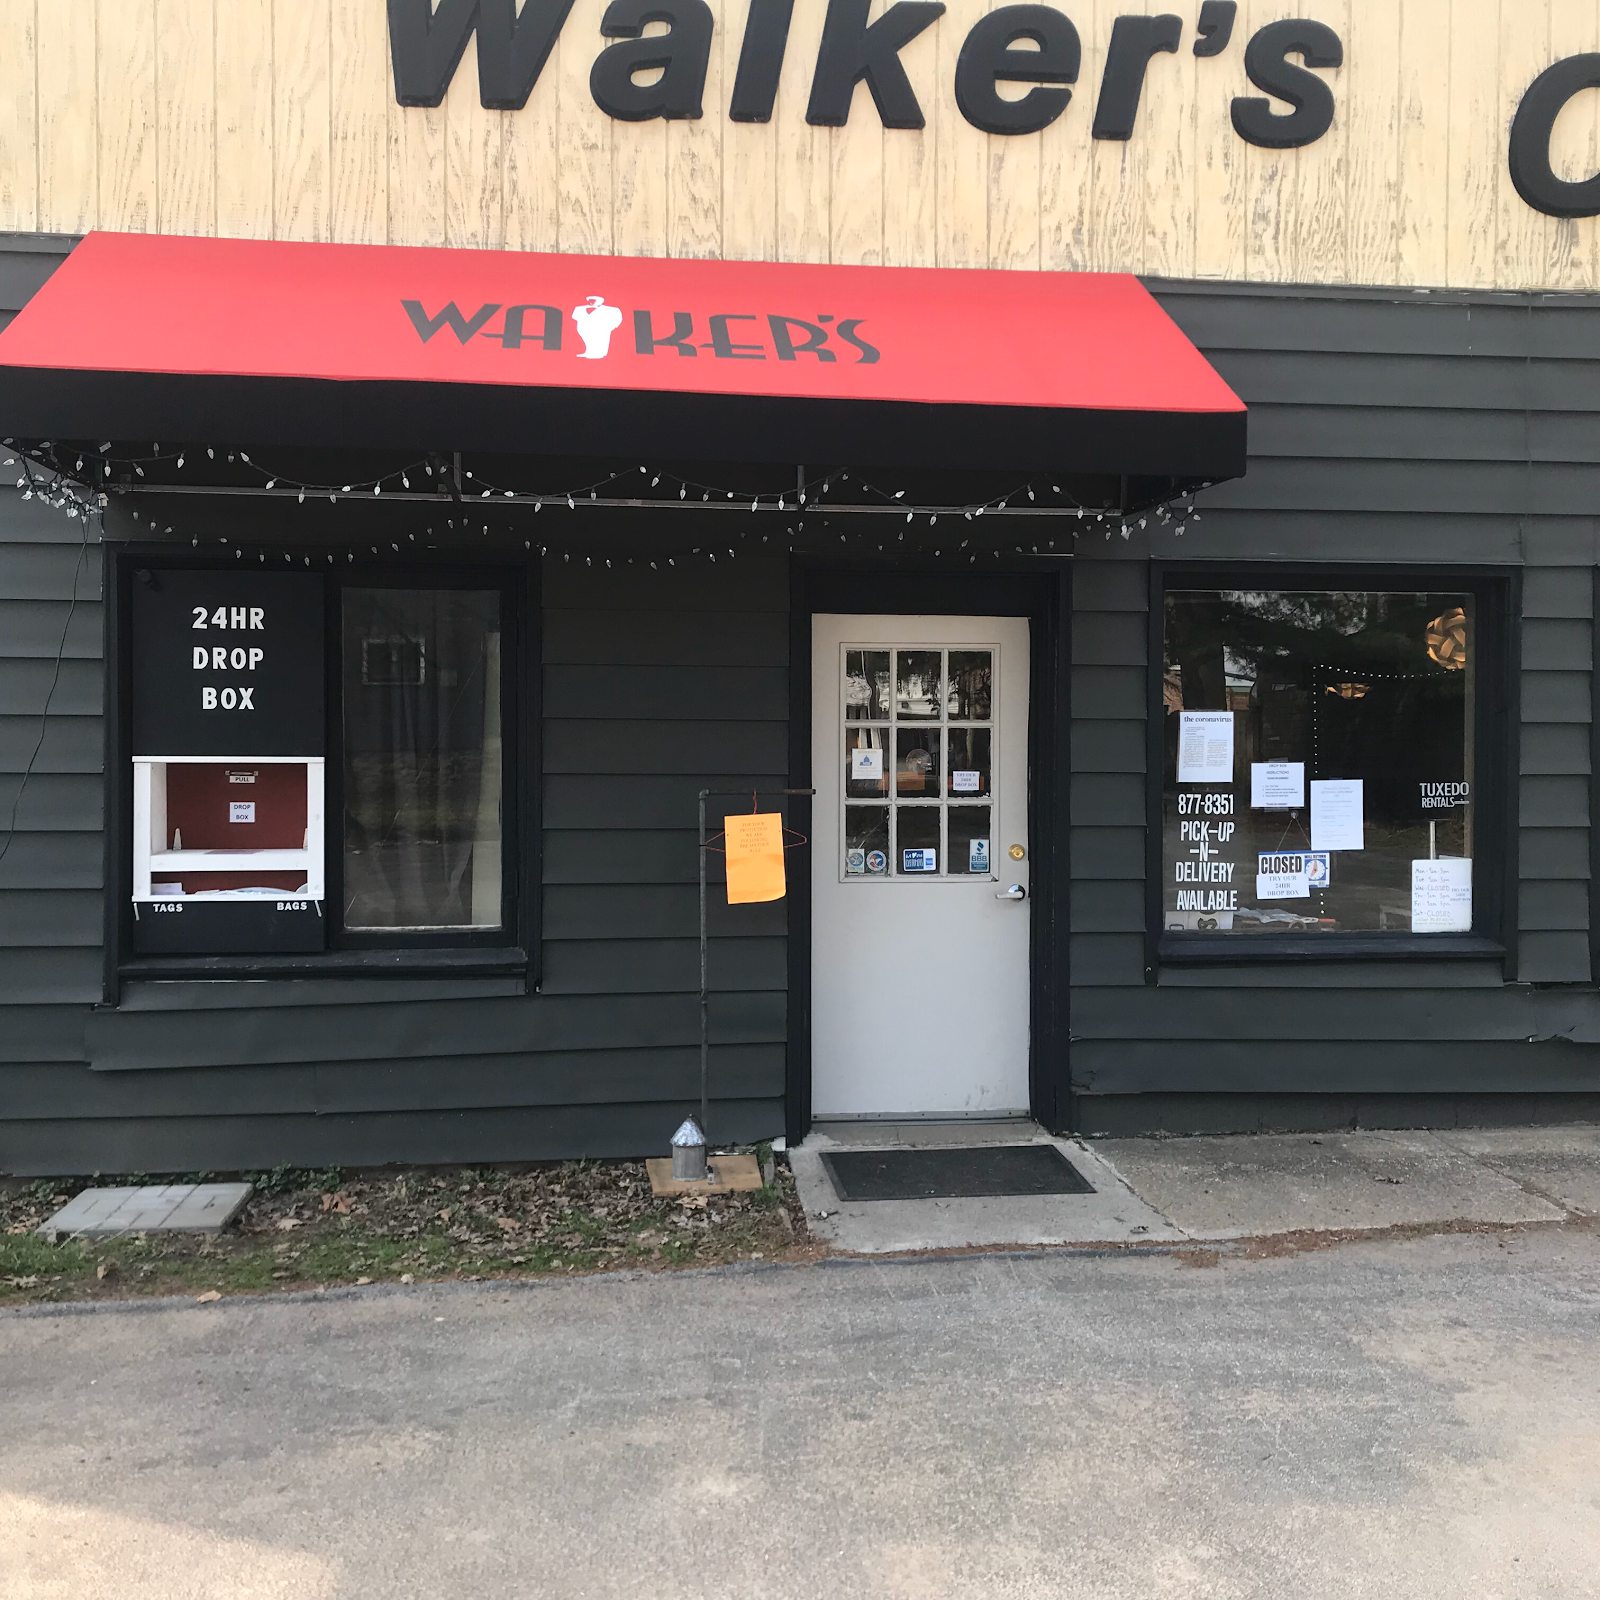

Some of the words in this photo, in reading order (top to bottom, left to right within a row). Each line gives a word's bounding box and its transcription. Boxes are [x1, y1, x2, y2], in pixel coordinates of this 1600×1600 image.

[387, 0, 1343, 149] Walker's
[401, 297, 881, 365] WAKER'S
[192, 606, 265, 630] 24HR
[193, 646, 264, 670] DROP
[202, 687, 255, 710] BOX
[1184, 715, 1194, 723] the
[1419, 781, 1470, 797] TUXEDO
[1178, 793, 1235, 815] 877-8351
[1421, 797, 1456, 808] RENTALS
[1180, 820, 1236, 842] PICK-UP
[1175, 861, 1235, 883] DELIVERY
[1260, 855, 1303, 875] CLOSED
[152, 903, 184, 913] TAGS
[276, 901, 308, 911] BAGS
[1176, 890, 1238, 911] AVAILABLE
